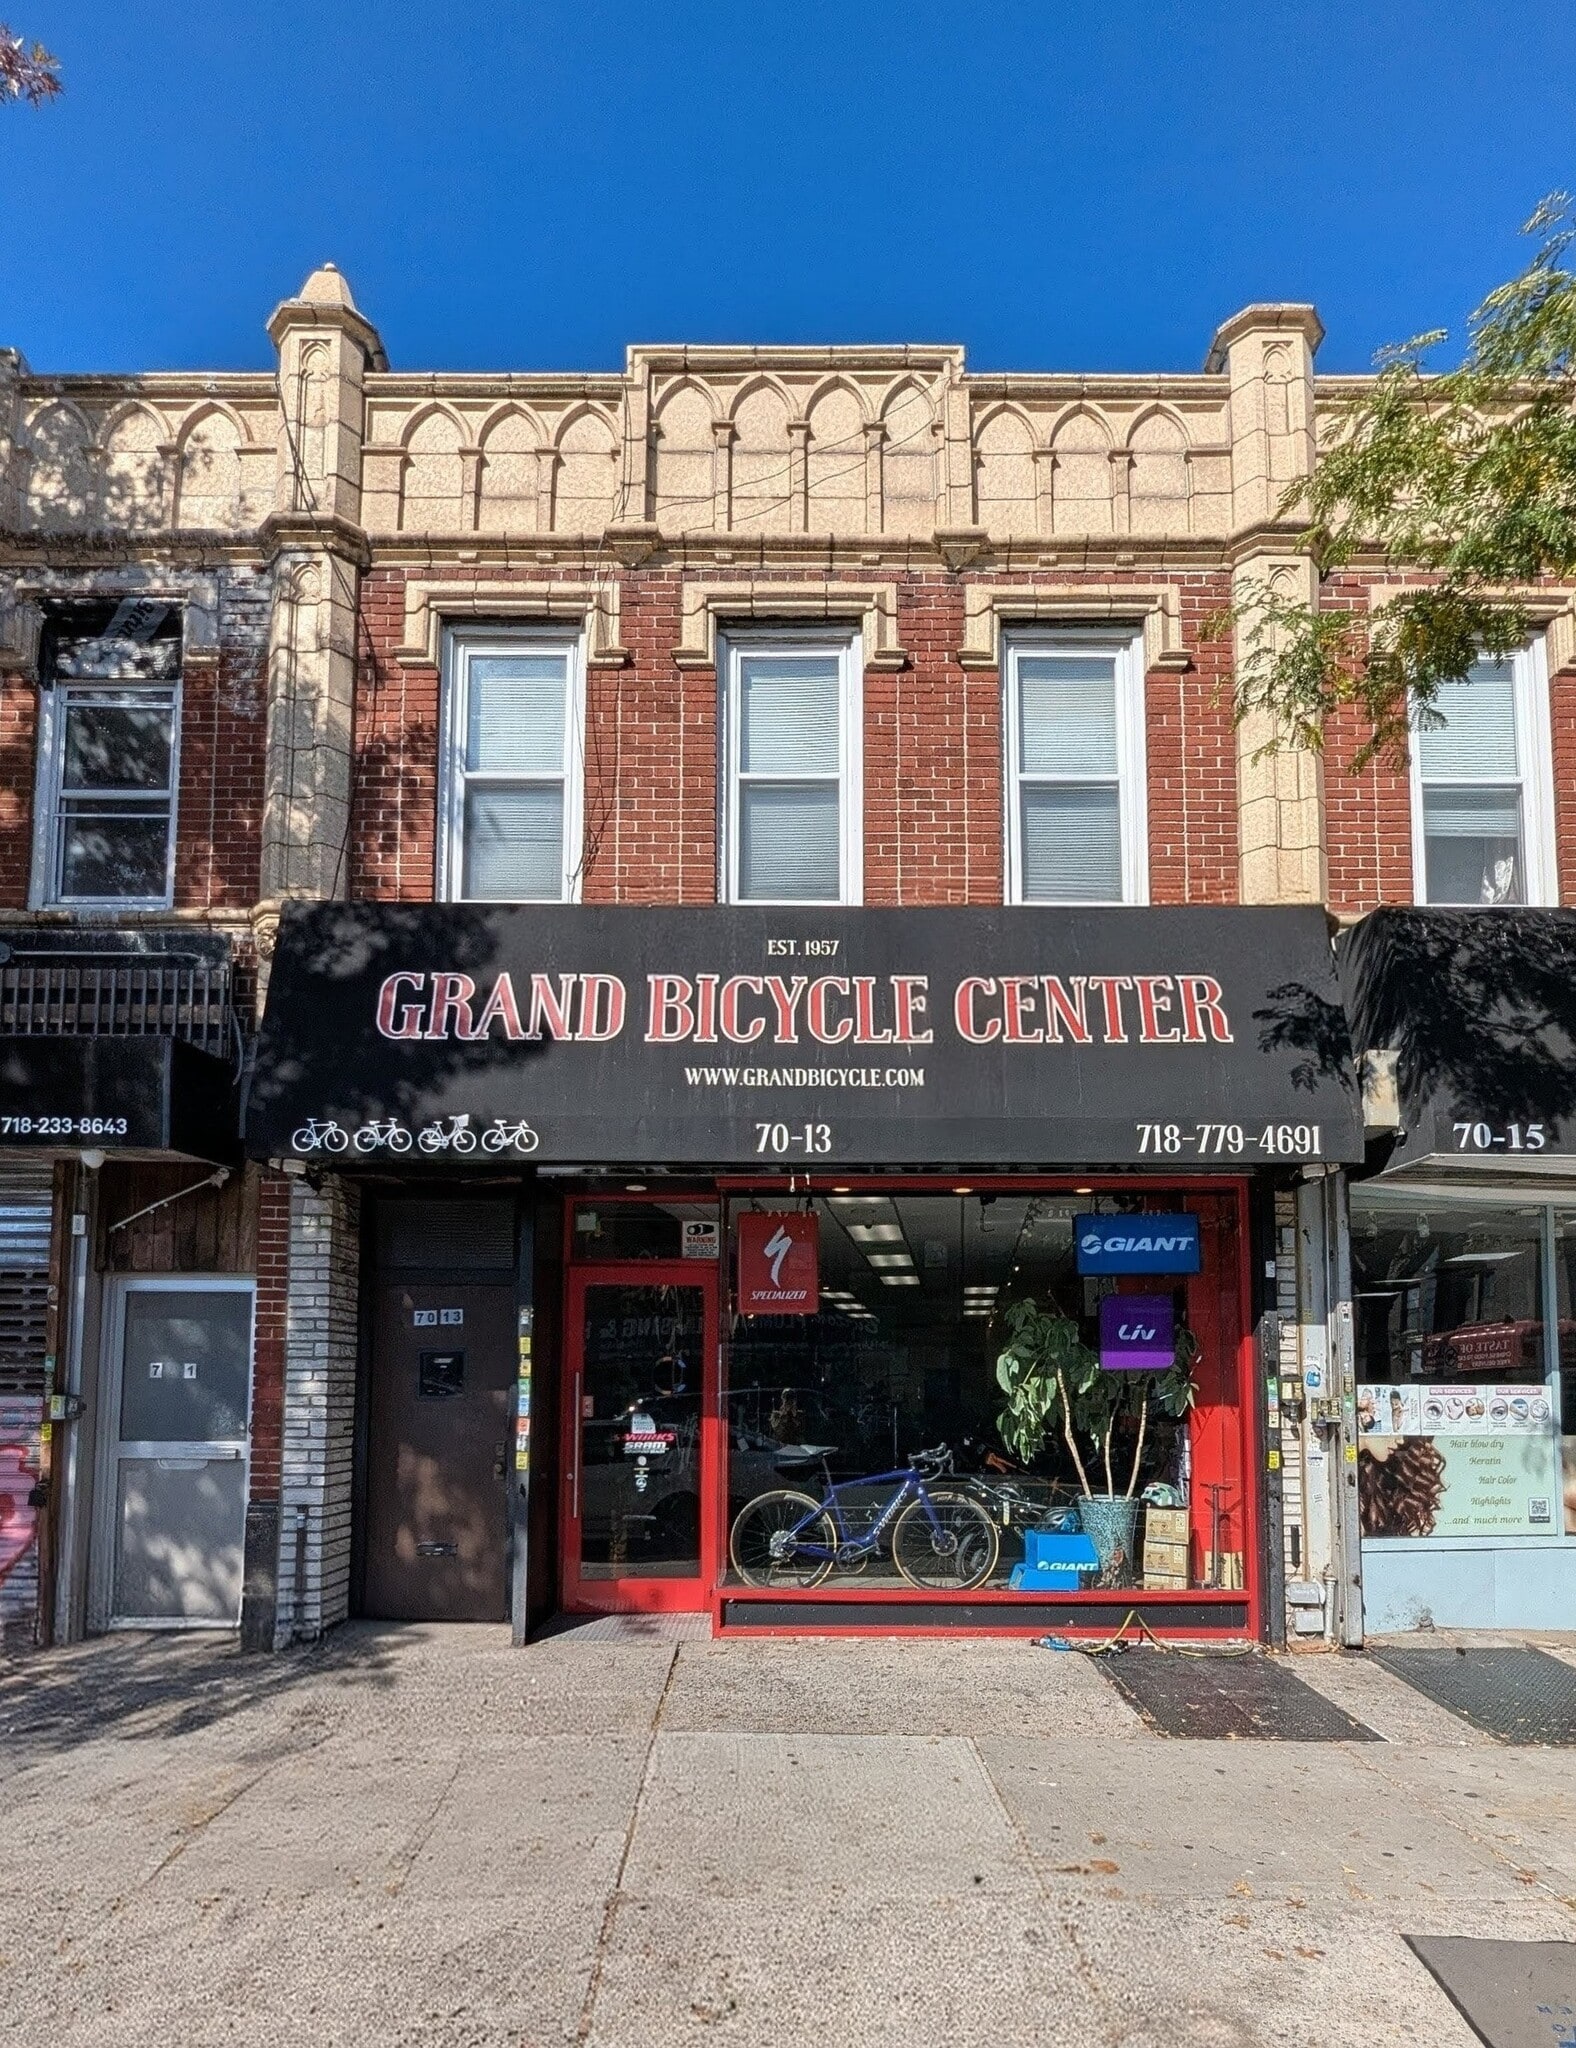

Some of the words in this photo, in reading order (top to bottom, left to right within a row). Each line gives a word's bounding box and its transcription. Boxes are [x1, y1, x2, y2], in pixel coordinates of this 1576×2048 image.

[767, 939, 801, 956] EST.
[805, 940, 840, 956] 1957
[376, 971, 626, 1041] GRAND
[644, 974, 933, 1044] BICYCLE
[954, 975, 1234, 1044] CENTER
[684, 1067, 925, 1087] WWW.GRANDBICYCLE.COM
[1, 1117, 127, 1134] 718-233-8643
[755, 1123, 832, 1153] 70-13
[1136, 1124, 1322, 1155] 718-779-4691
[1453, 1123, 1545, 1149] 70-15
[1103, 1237, 1194, 1252] GIANT
[750, 1290, 808, 1300] SPECIALIZED
[1118, 1324, 1156, 1340] Liv
[152, 1365, 160, 1376] 7
[187, 1365, 194, 1377] 1
[1450, 1439, 1469, 1448] Hair
[1470, 1439, 1489, 1448] blow
[1490, 1439, 1505, 1450] dry
[1469, 1457, 1502, 1465] Keratin
[1479, 1476, 1497, 1485] Hair
[1498, 1475, 1518, 1485] Color
[1470, 1496, 1512, 1507] Highlights
[1474, 1515, 1498, 1524] much
[1050, 1562, 1098, 1571] GIANT
